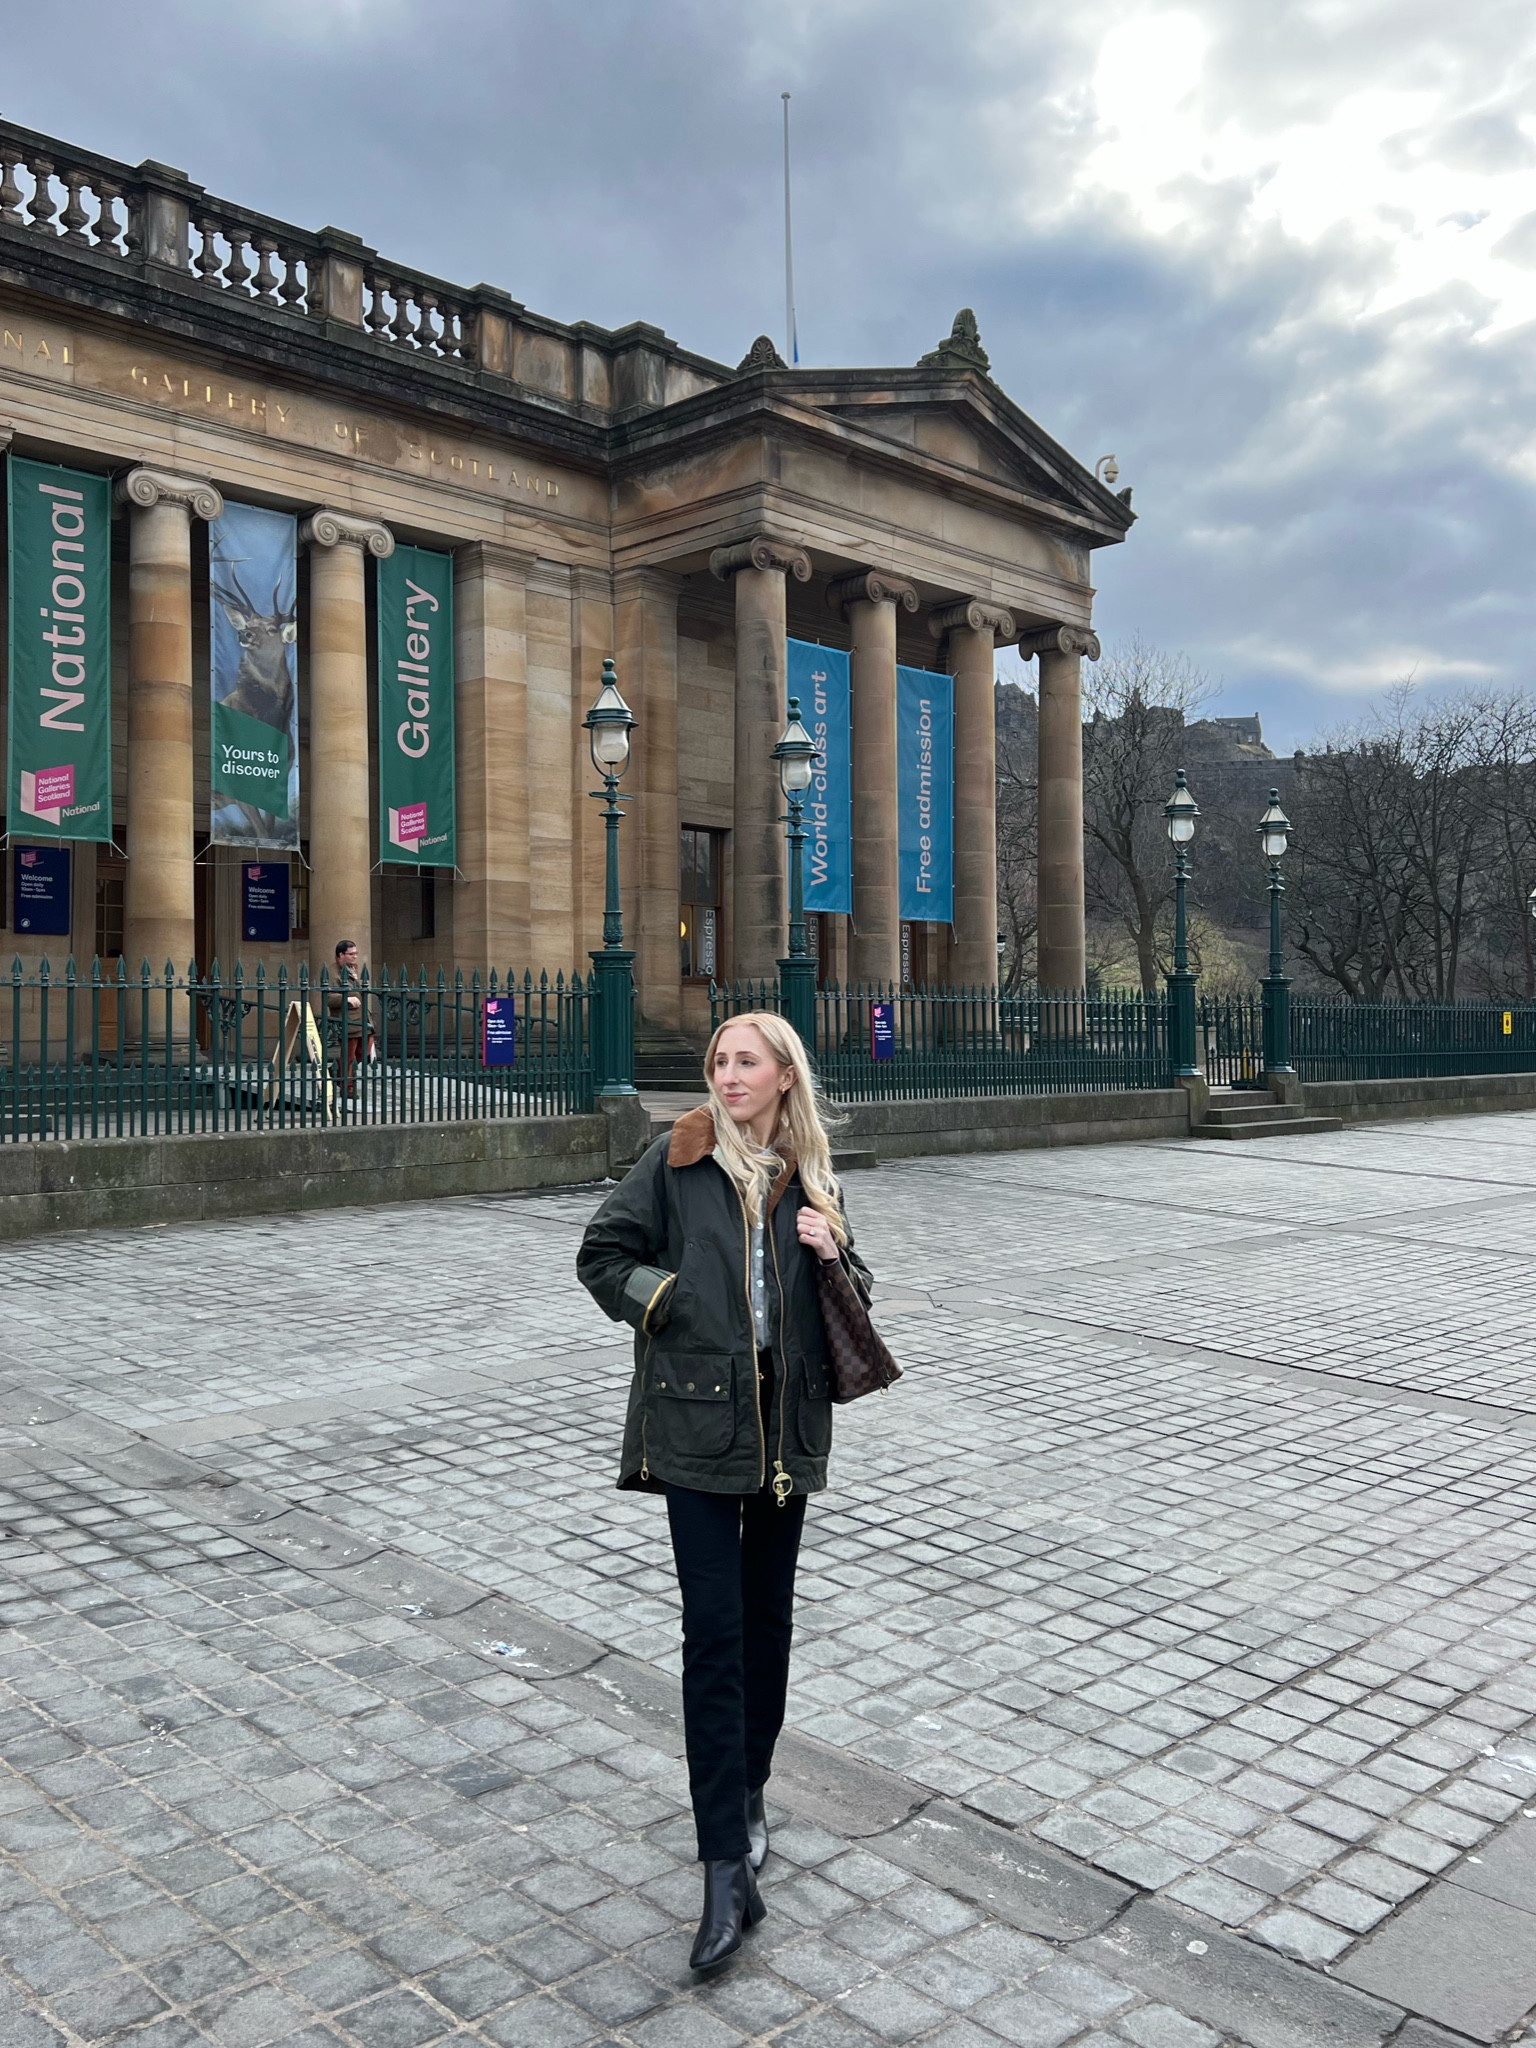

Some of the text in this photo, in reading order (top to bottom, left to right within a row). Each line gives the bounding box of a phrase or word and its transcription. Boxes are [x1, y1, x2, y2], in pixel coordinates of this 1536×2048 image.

[131, 366, 290, 423] GALLERY
[336, 421, 369, 443] OF
[409, 442, 559, 498] SCOTLAND
[38, 483, 86, 732] National
[397, 578, 439, 758] Gallery
[221, 744, 279, 764] Yours to
[221, 761, 280, 779] discover
[810, 670, 828, 886] World-class art
[38, 773, 69, 786] National
[38, 783, 70, 794] Galleries
[38, 790, 71, 803] Scotland
[916, 699, 932, 893] Free admission
[62, 801, 100, 818] National
[401, 810, 424, 821] National
[401, 818, 425, 828] Galleries
[401, 824, 425, 835] Scotland
[419, 832, 448, 847] National
[20, 873, 54, 882] Welcome
[248, 886, 276, 895] Welcome
[703, 909, 715, 975] Espresso
[901, 924, 910, 983] Espresso
